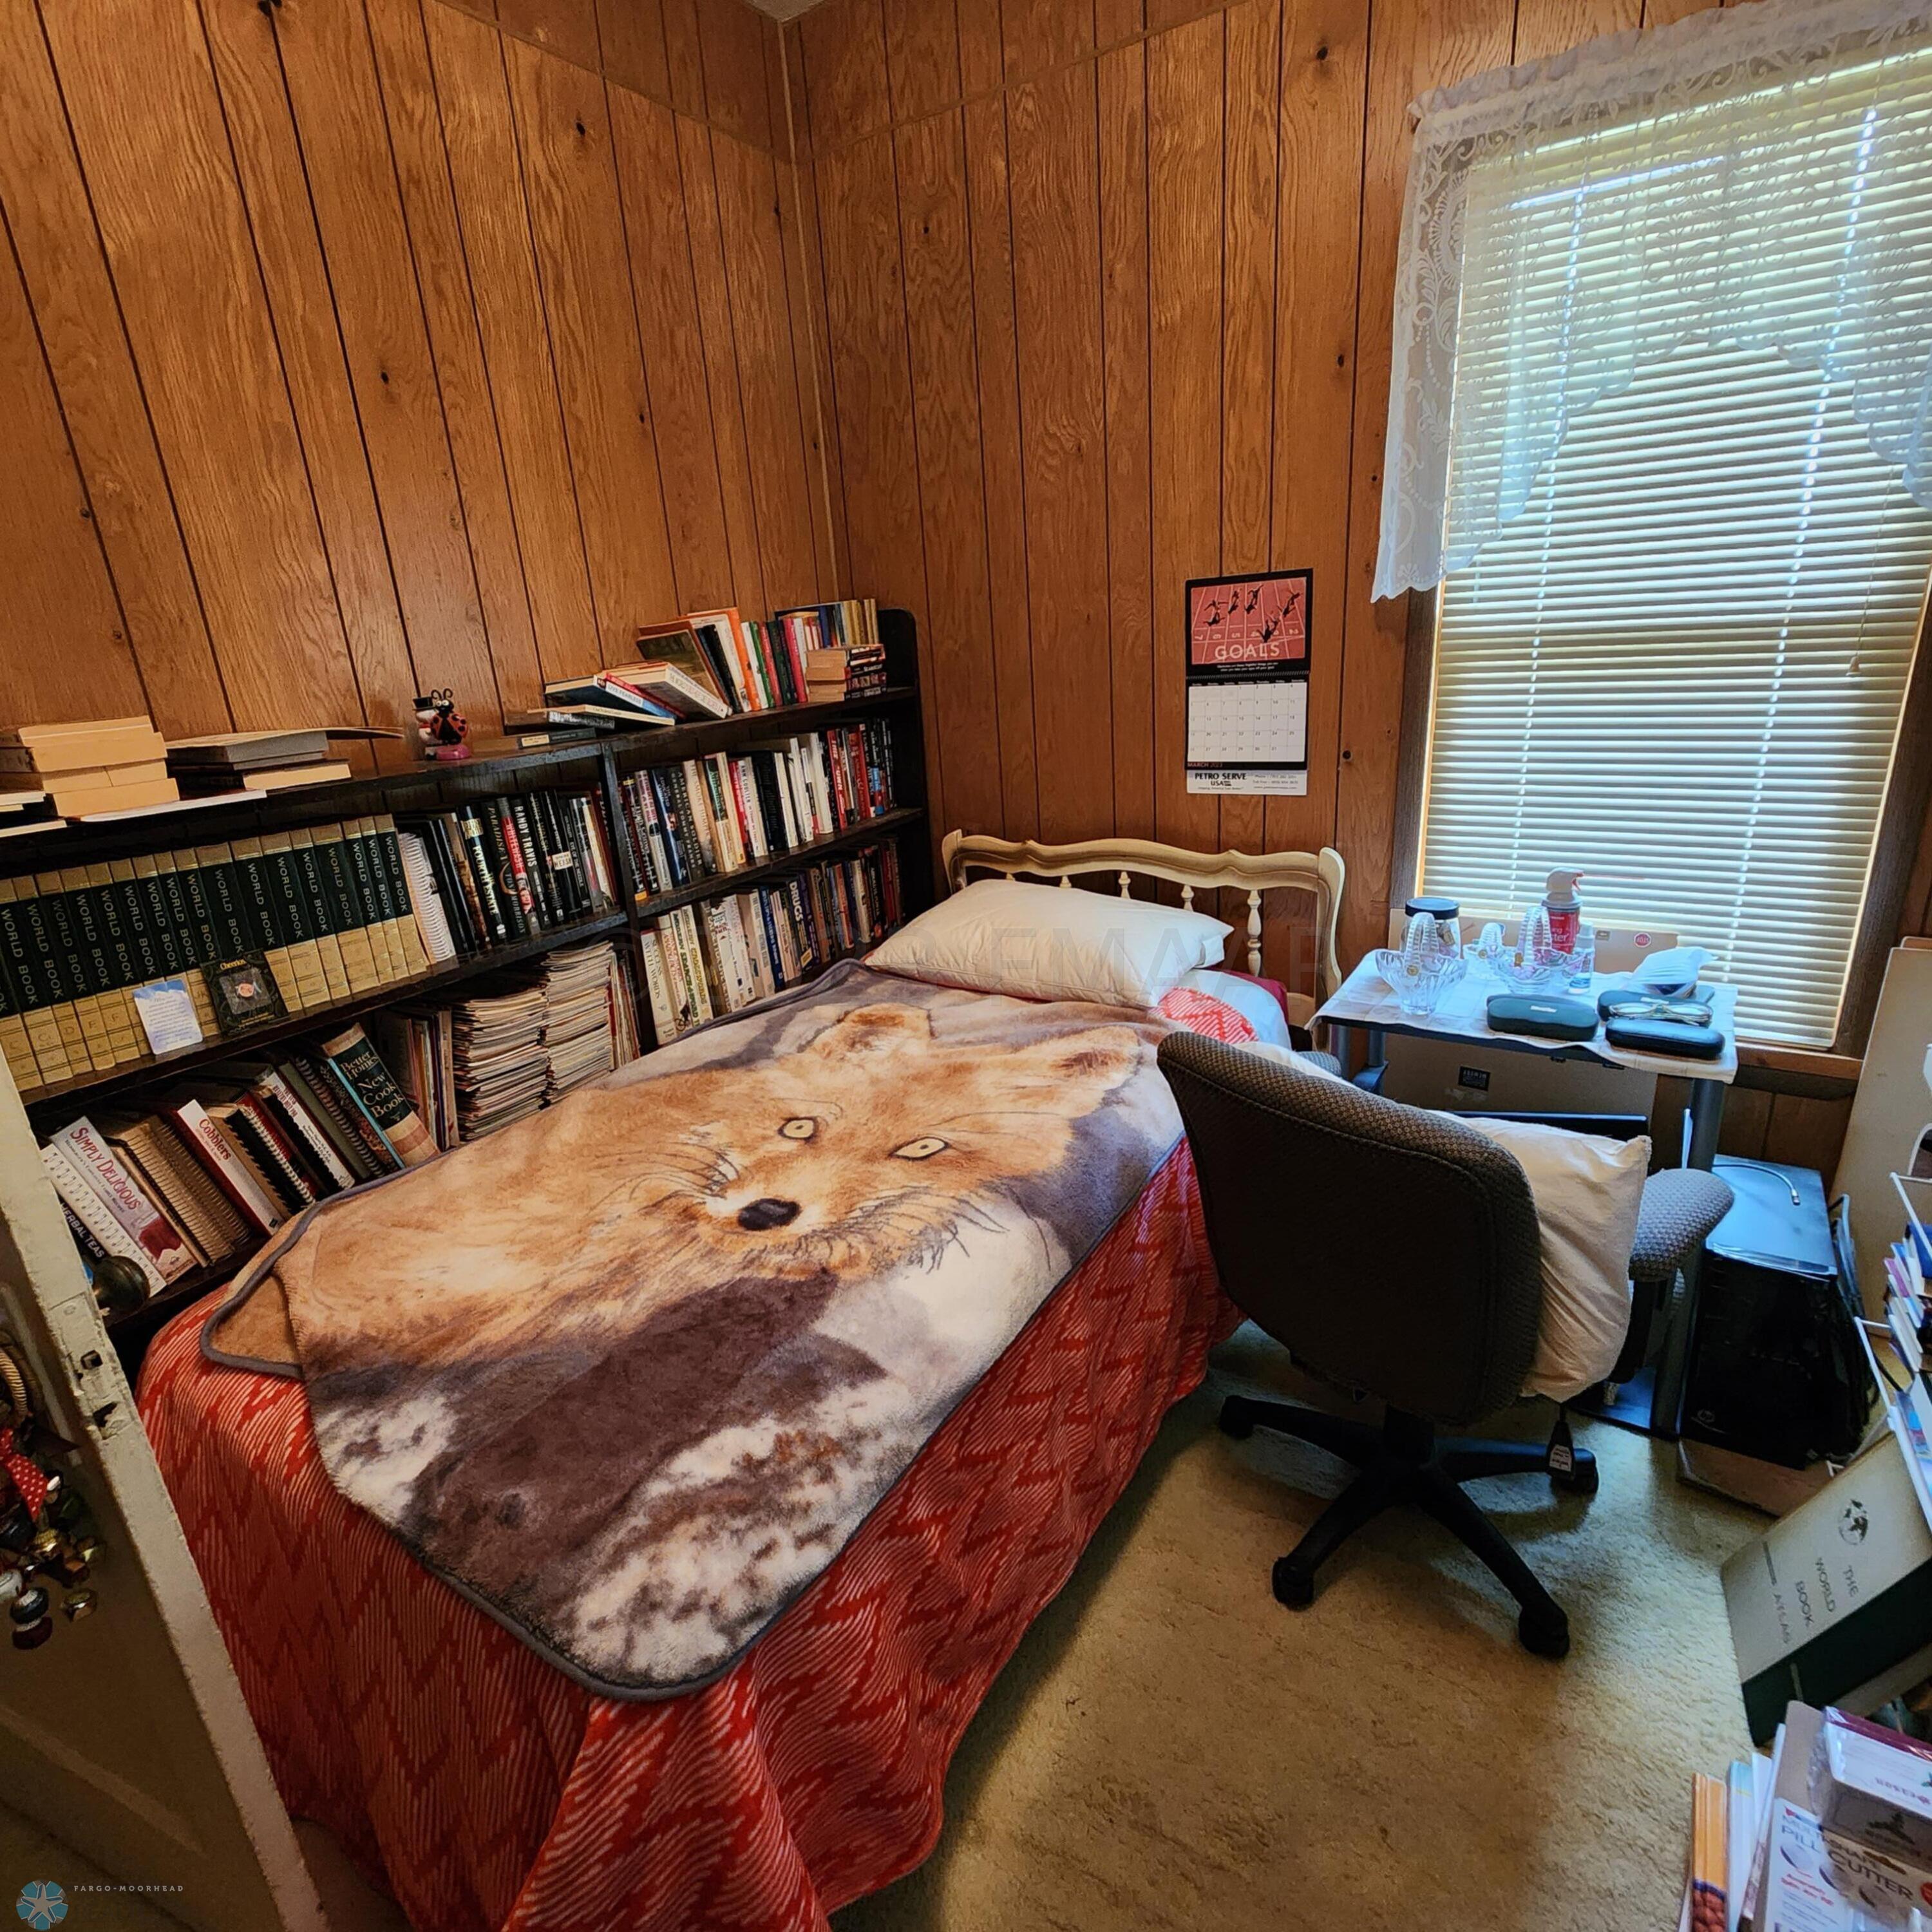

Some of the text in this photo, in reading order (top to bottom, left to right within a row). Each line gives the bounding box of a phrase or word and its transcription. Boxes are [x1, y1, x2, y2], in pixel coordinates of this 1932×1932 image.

[1215, 641, 1280, 659] GOALS
[688, 763, 697, 777] THE
[486, 806, 507, 853] PARADISE
[513, 805, 537, 867] RANDY TRAVIS
[536, 822, 550, 851] WALSH
[670, 772, 696, 868] GENERAL TOMMY FRANKS
[677, 771, 703, 866] AMERICAN SOLDIER
[214, 869, 244, 954] WORLD BOOK
[247, 862, 276, 946] WORLD BOOK
[277, 857, 304, 939] WORLD BOOK
[303, 852, 328, 933] WORLD BOOK
[328, 848, 353, 926] WORLD BOOK
[353, 842, 376, 920] WORLD BOOK
[368, 838, 392, 916] WORLD BOOK
[386, 836, 408, 912] WORLD BOOK
[473, 845, 489, 884] FOURTH
[483, 883, 499, 916] ESTATE
[790, 881, 803, 922] DRUGS
[26, 904, 64, 998] WORLD BOOK
[52, 900, 87, 992] WORLD BOOK
[76, 894, 110, 987] WORLD BOOK
[100, 891, 134, 981] WORLD BOOK
[124, 886, 156, 975] WORLD BOOK
[147, 882, 178, 971] WORLD BOOK
[166, 878, 196, 965] WORLD BOOK
[187, 874, 216, 960] WORLD BOOK
[509, 894, 527, 933] MORRISON
[1, 909, 38, 1005] WORLD BOOK
[644, 940, 661, 999] WITH WORDS
[650, 938, 663, 976] SUCCESS
[662, 933, 677, 977] AMAZING FACTS
[672, 913, 699, 1018] MODERN SEARCH-A-WORD
[682, 908, 708, 1005] MODERN CROSSWORDS
[340, 1051, 371, 1072] Better
[348, 1056, 379, 1081] Homes
[357, 1072, 386, 1094] New
[363, 1082, 397, 1106] Cook
[199, 1118, 232, 1161] Cobblers
[370, 1093, 404, 1118] Book
[70, 1127, 104, 1162] SIMPLY
[97, 1159, 142, 1210] DELICIOUS
[61, 1202, 106, 1258] HERBAL TEAS
[1773, 1593, 1790, 1644] ATLAS
[1795, 1581, 1814, 1627] BOOK
[1815, 1557, 1835, 1612] WORLD
[1843, 1565, 1859, 1597] THE
[1782, 1825, 1821, 1854] PILL
[1828, 1850, 1913, 1900] CUTTER
